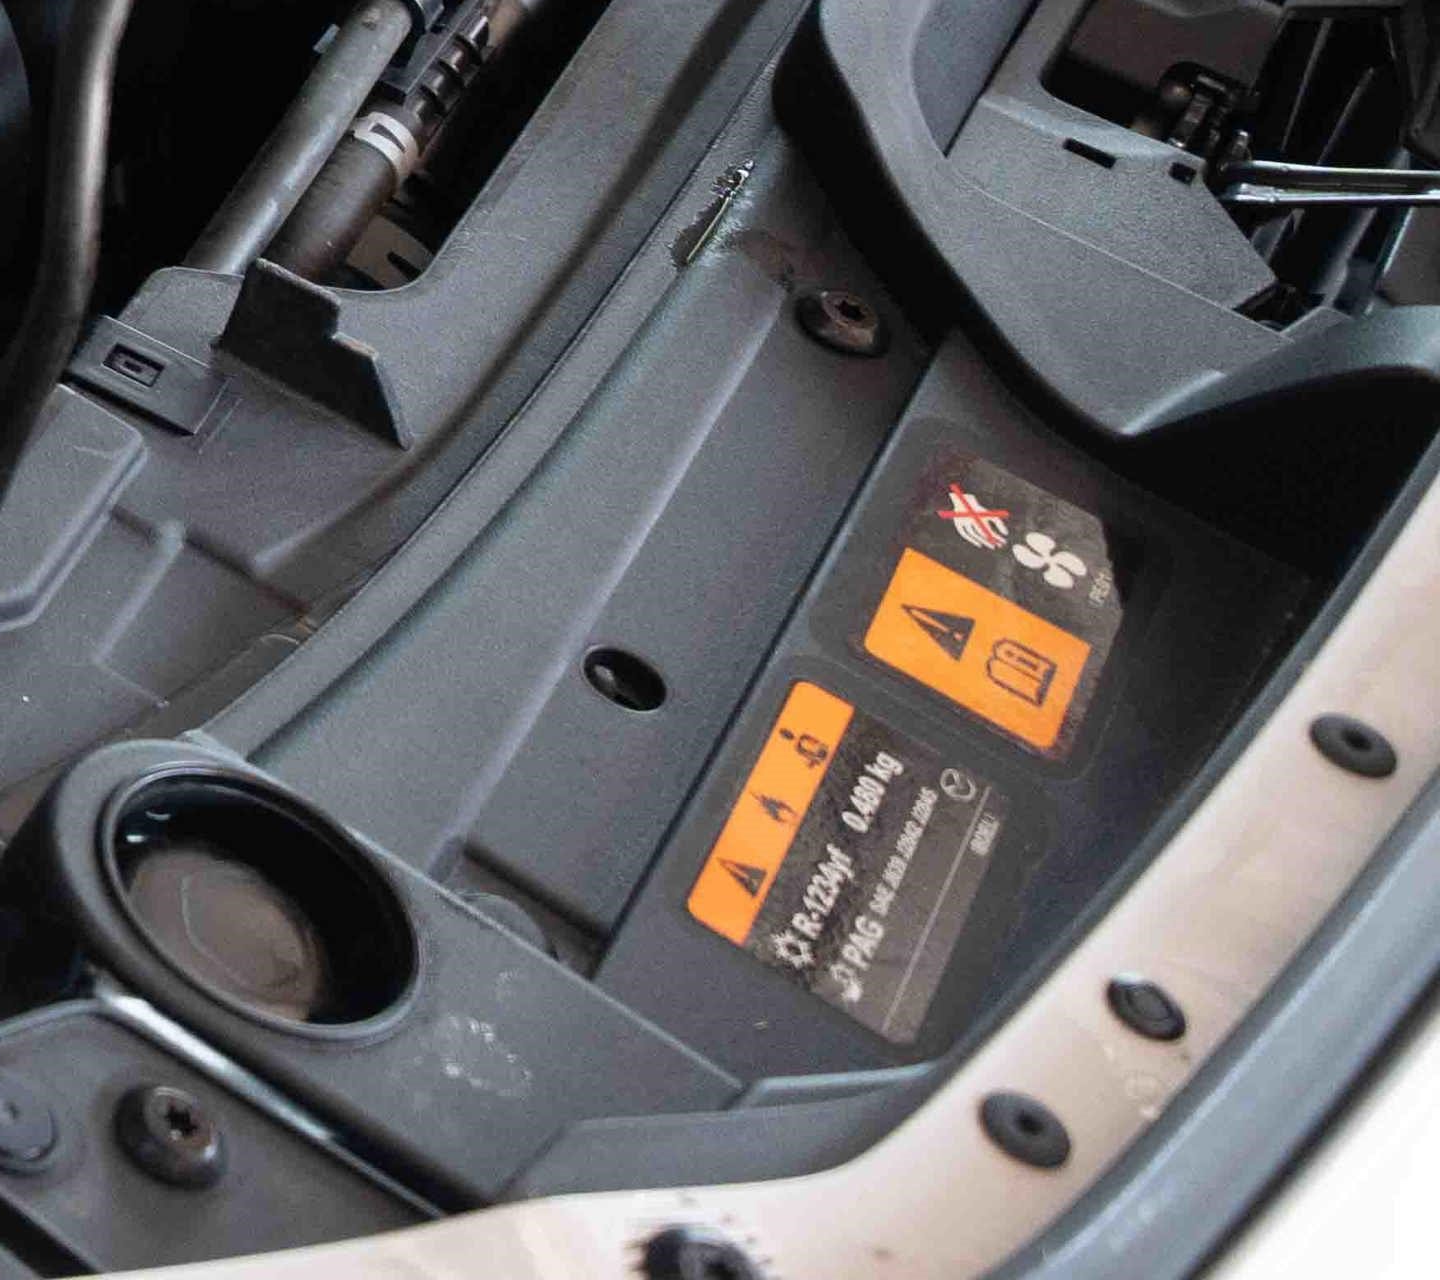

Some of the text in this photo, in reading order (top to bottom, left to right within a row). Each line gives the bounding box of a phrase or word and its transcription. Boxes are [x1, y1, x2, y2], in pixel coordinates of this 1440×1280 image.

[792, 842, 855, 940] R-1234yf
[864, 751, 905, 784] kg
[842, 914, 885, 971] PAG
